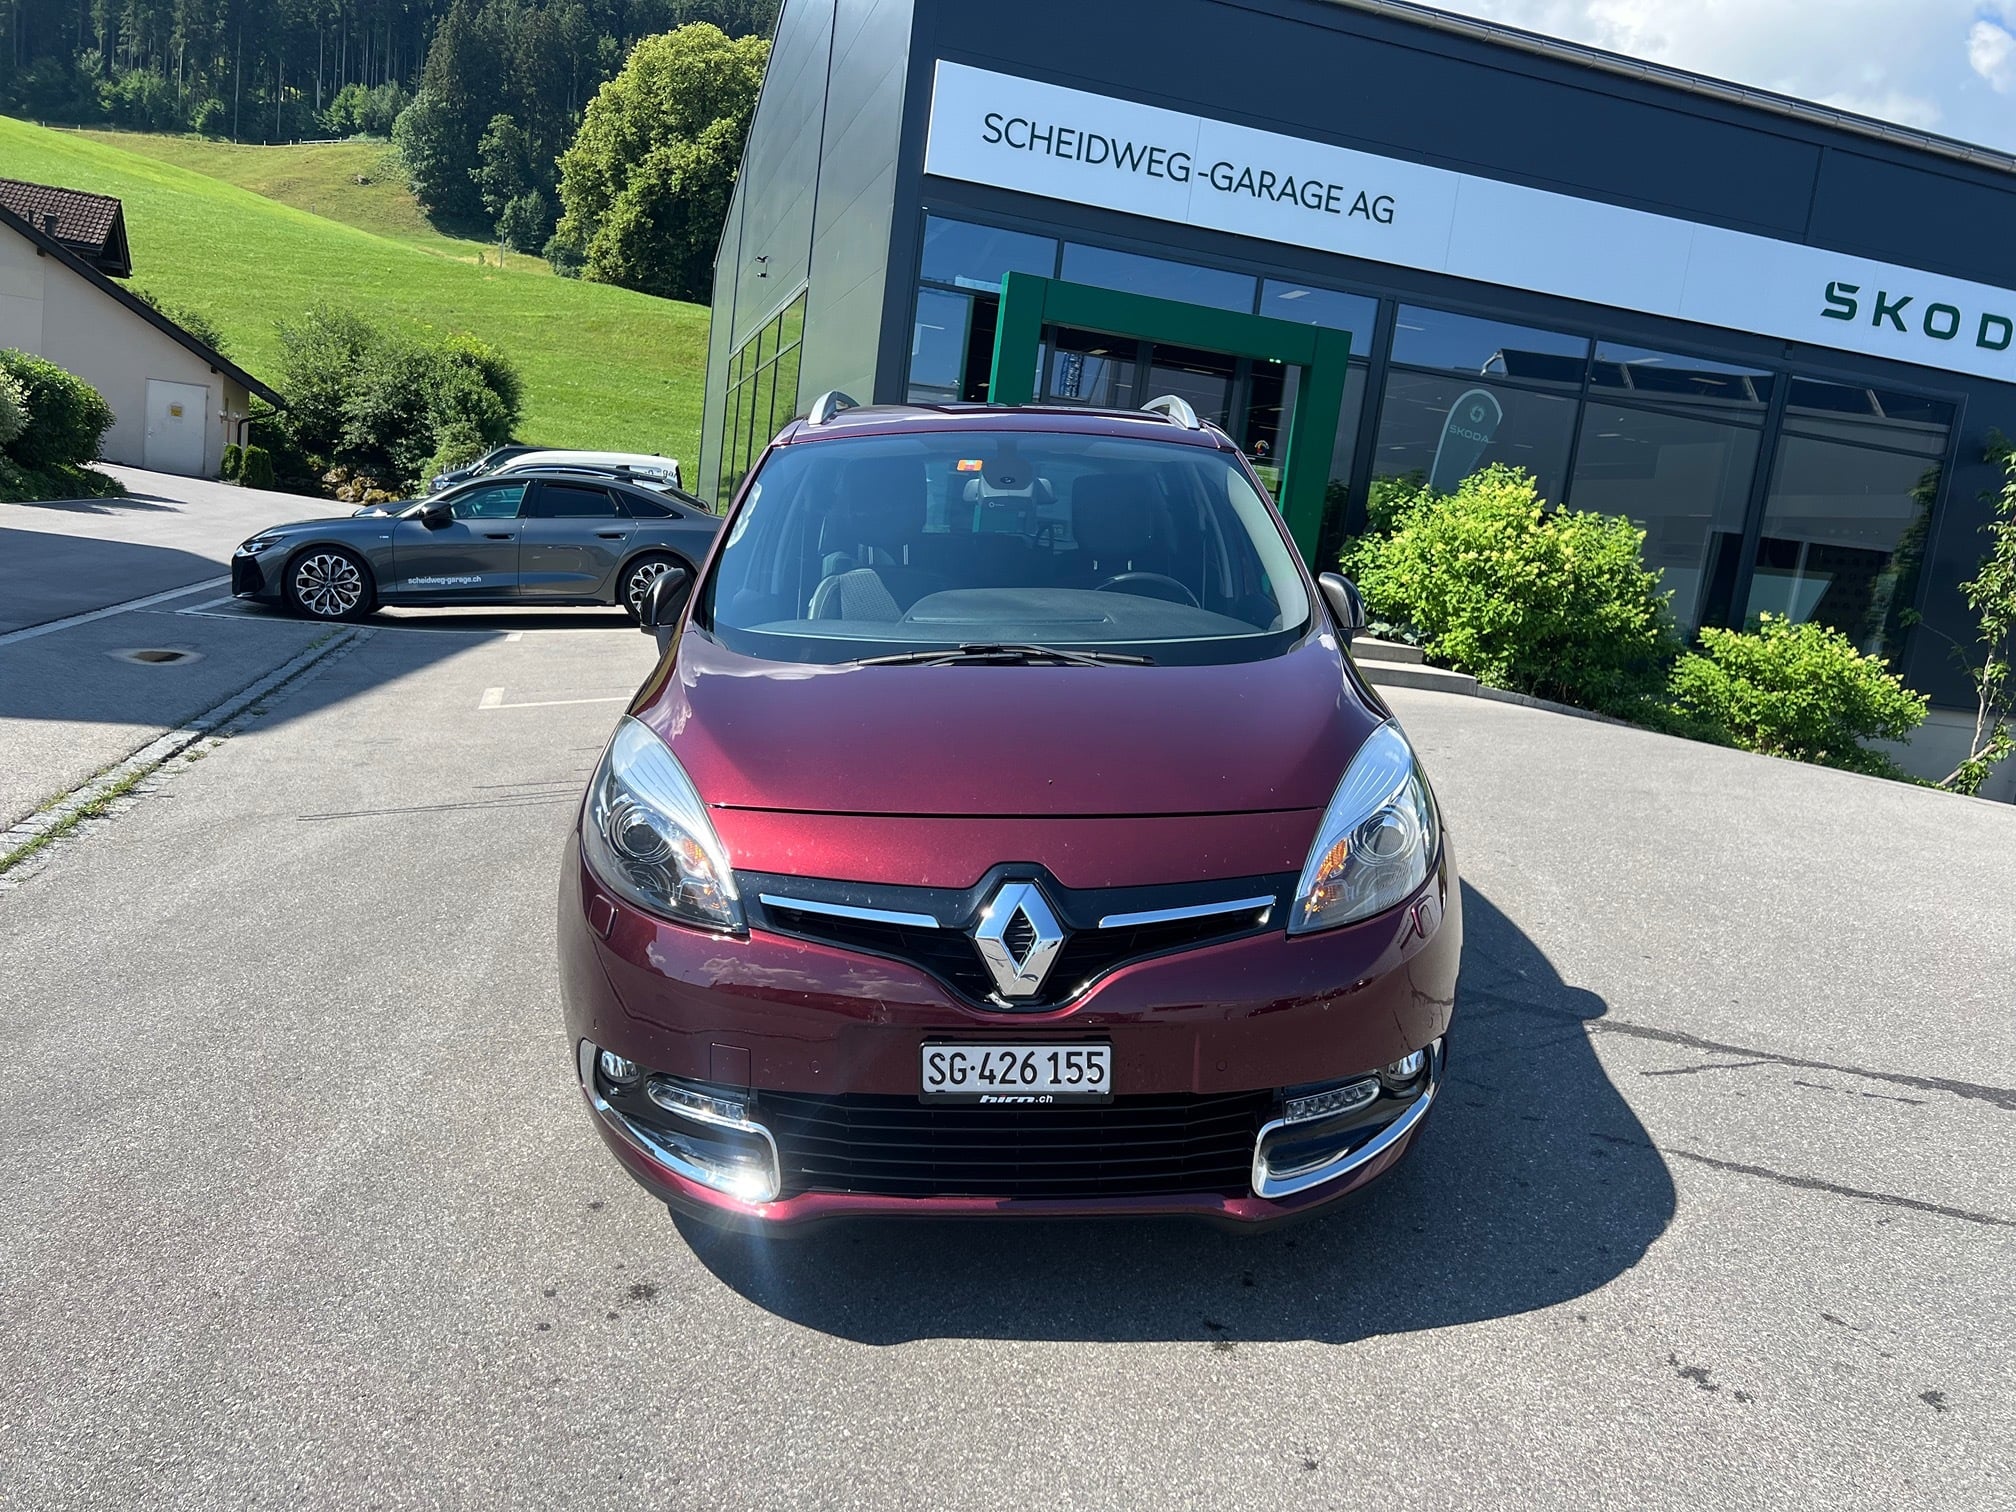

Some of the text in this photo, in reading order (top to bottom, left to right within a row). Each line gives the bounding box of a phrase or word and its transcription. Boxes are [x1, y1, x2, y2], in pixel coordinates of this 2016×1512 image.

[982, 112, 1395, 224] SCHEIDWEG-GARAGE AG
[1449, 424, 1489, 443] SKODA
[408, 575, 482, 585] scheidweg-garage.ch
[1047, 1051, 1105, 1085] 155
